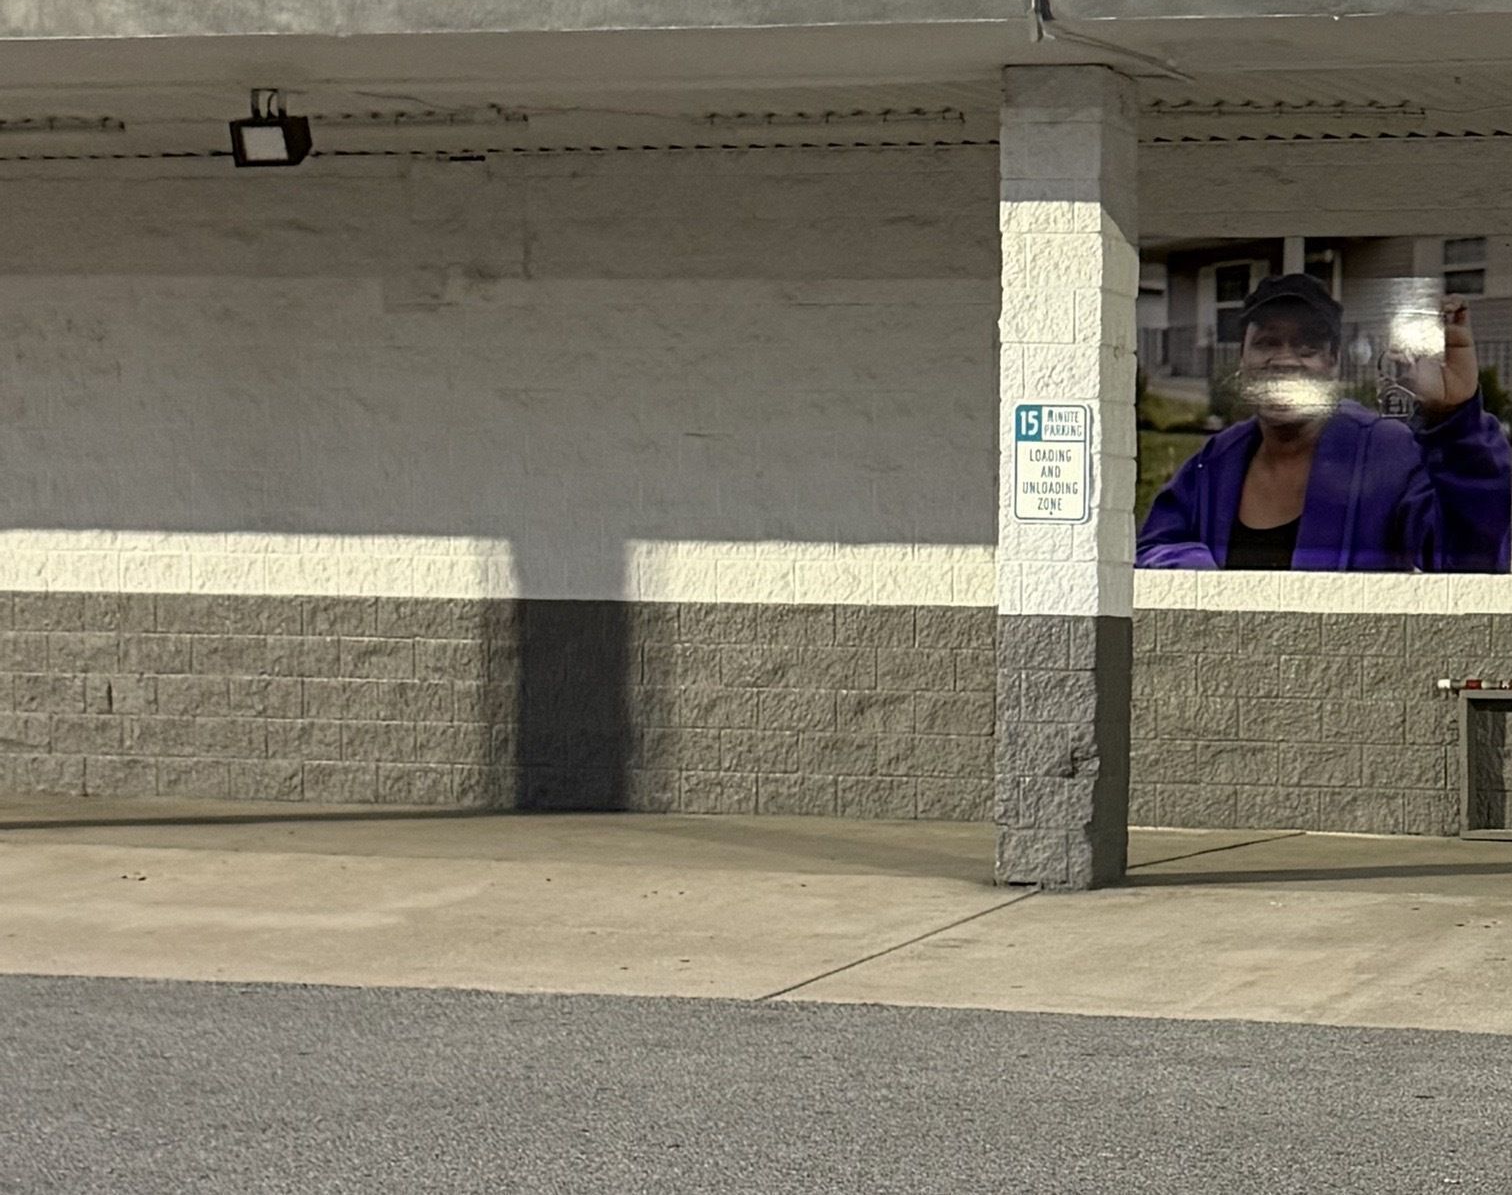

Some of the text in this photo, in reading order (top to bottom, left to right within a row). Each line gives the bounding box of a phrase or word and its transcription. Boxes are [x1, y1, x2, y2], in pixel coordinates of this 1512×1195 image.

[1019, 409, 1040, 437] 15
[1044, 423, 1083, 438] PARKING
[1029, 448, 1072, 463] LOADING
[1040, 465, 1061, 479] AND
[1022, 481, 1079, 496] UNLOADING
[1037, 497, 1063, 512] ZONE
